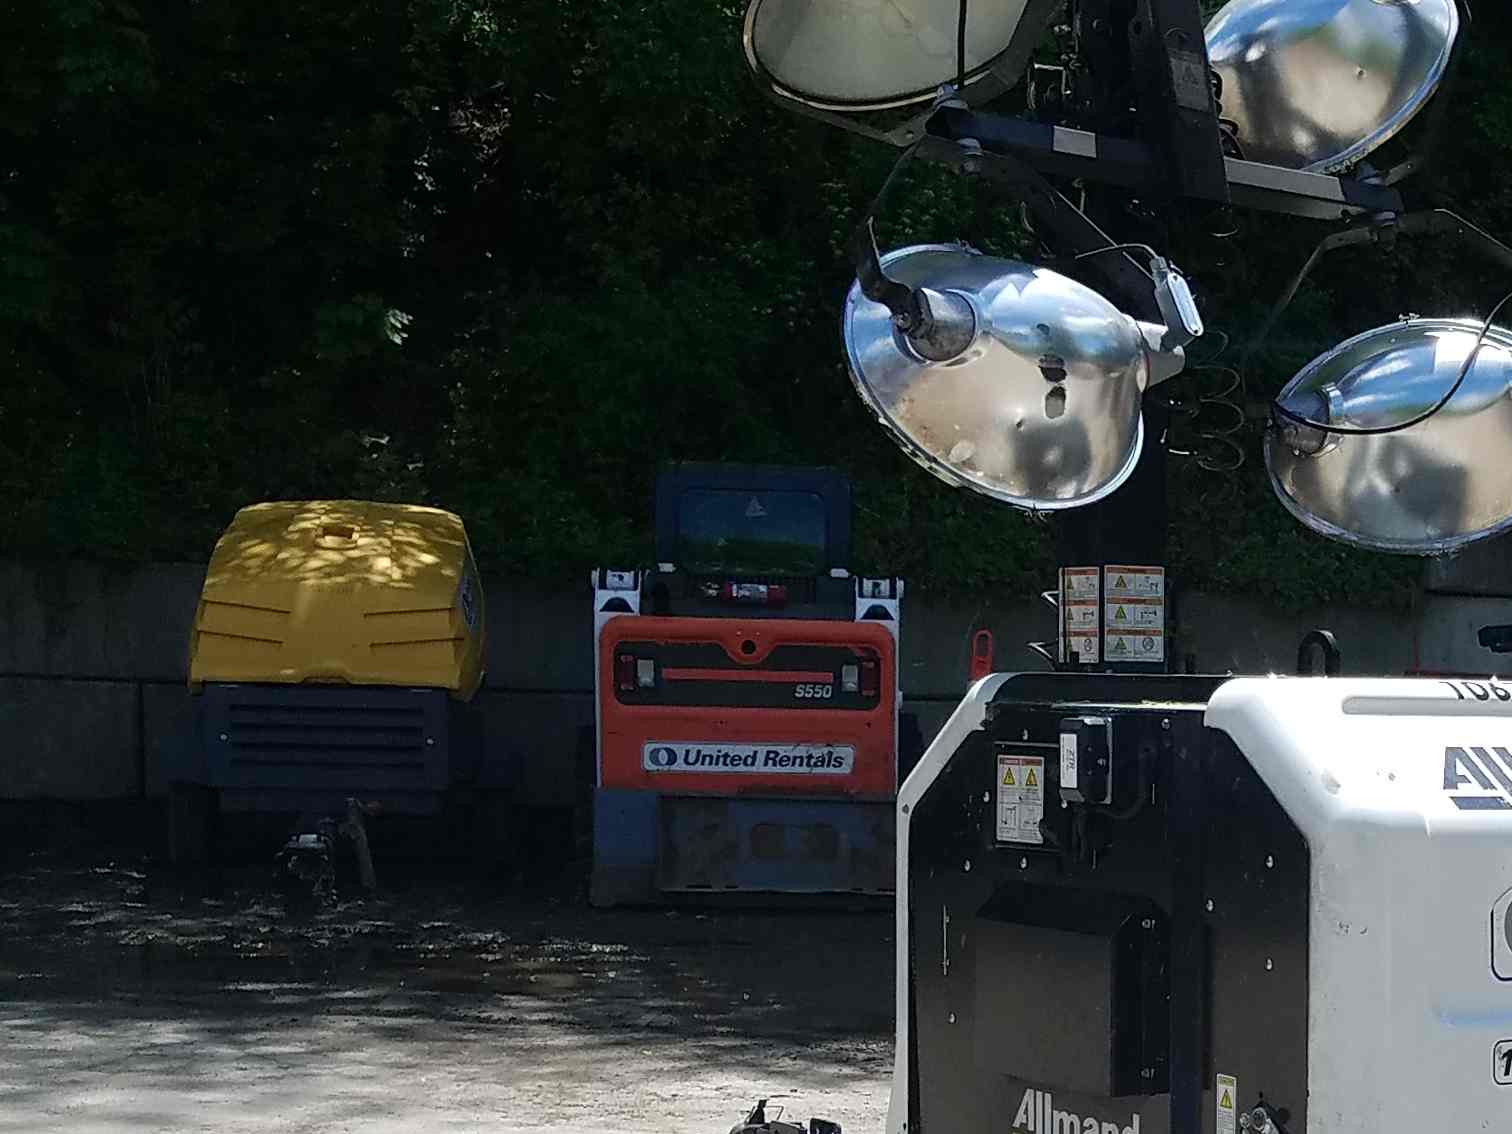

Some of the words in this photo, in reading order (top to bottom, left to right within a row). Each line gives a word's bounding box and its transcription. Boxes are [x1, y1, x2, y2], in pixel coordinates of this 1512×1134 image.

[794, 684, 832, 698] S550
[683, 749, 758, 768] United
[763, 750, 845, 769] Rentals
